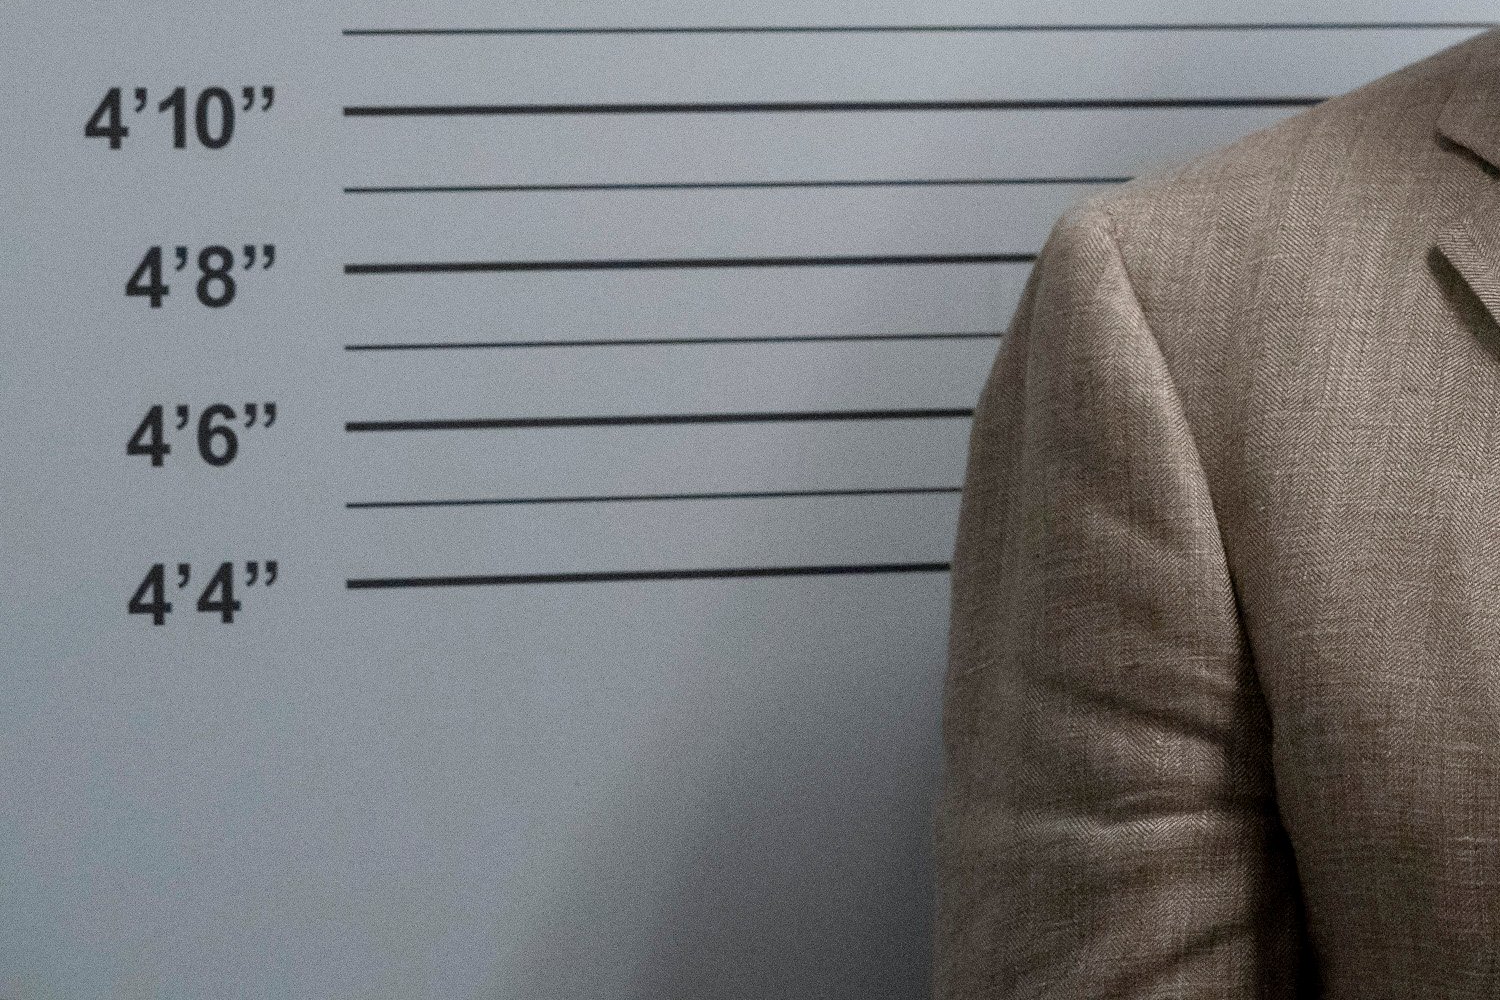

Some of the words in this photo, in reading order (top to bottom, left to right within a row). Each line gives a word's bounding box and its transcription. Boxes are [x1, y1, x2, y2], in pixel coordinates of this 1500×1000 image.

[84, 85, 275, 151] 4’10”
[124, 244, 276, 309] 4’8”
[126, 402, 277, 468] 4’6”
[127, 560, 279, 626] 4’4”
